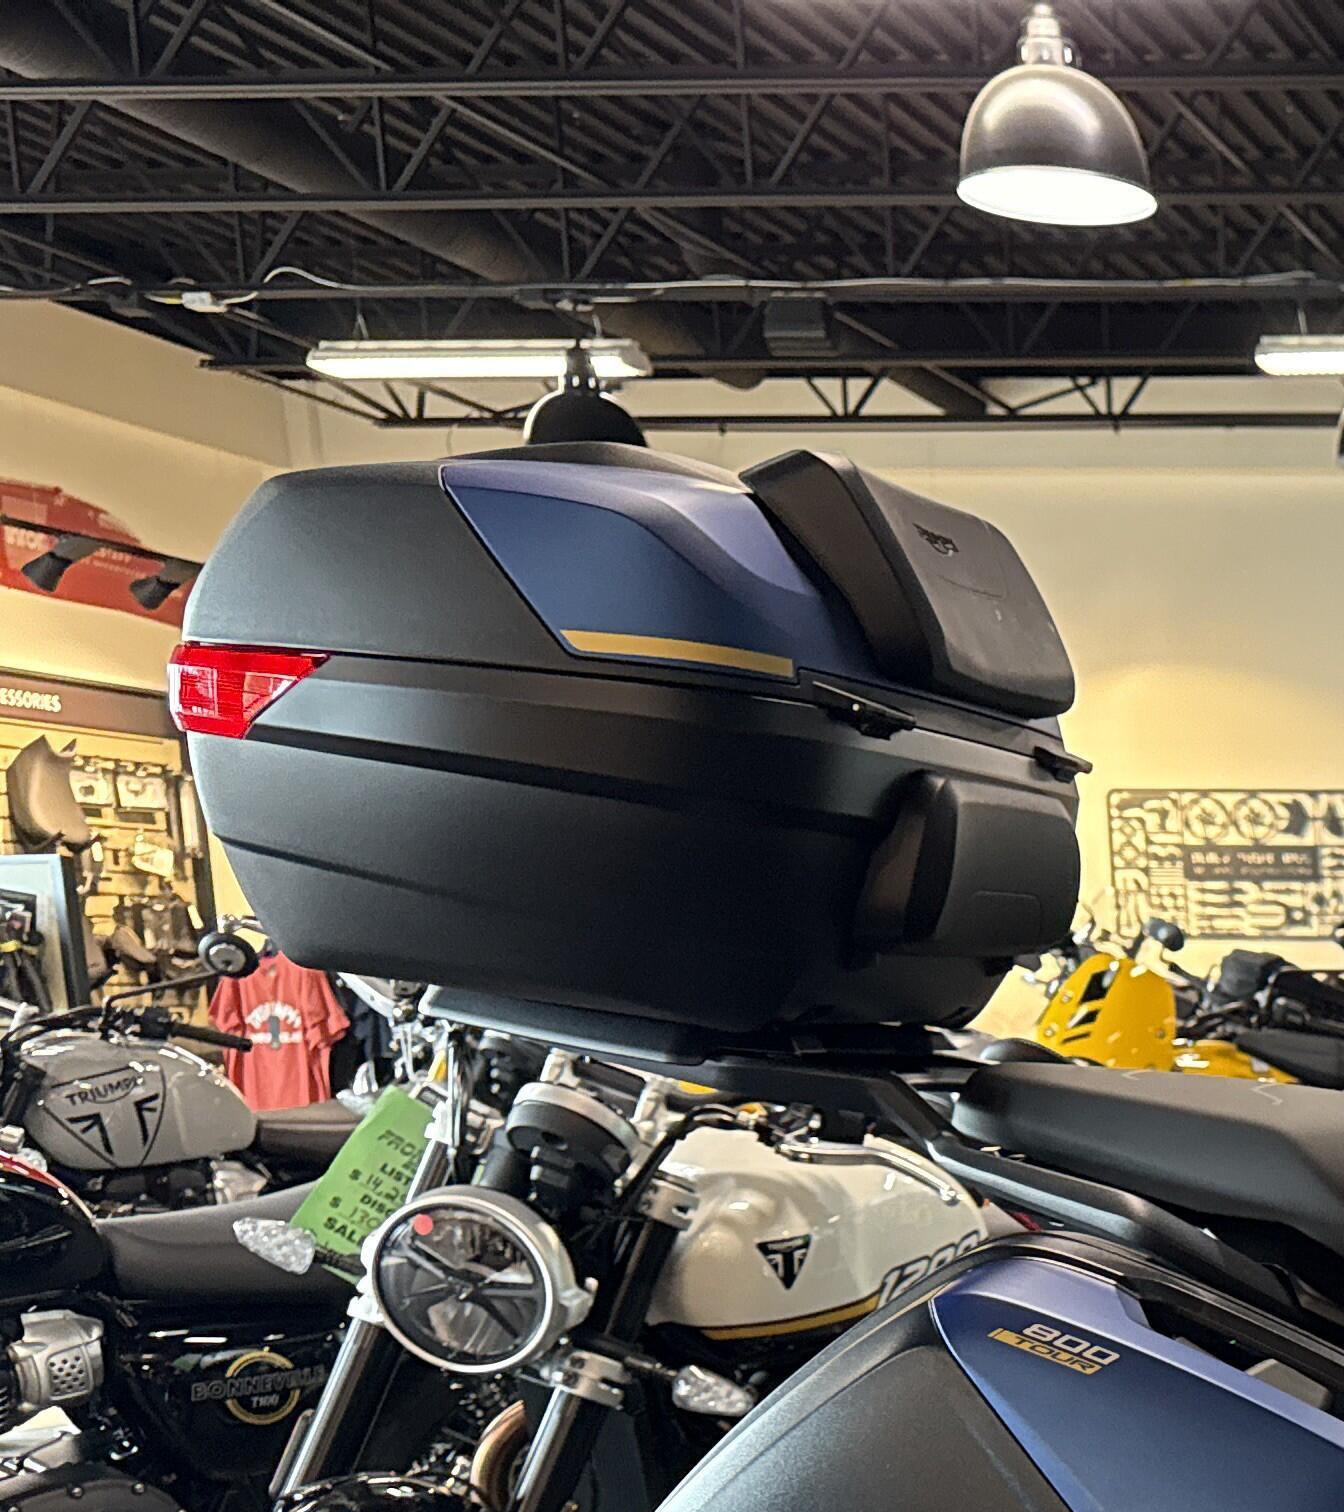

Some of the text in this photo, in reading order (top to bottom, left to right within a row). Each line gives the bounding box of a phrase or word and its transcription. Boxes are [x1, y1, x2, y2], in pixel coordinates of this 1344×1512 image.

[65, 1073, 143, 1106] TRIUMP
[379, 1162, 412, 1186] LIST
[1013, 1337, 1096, 1372] TOUR
[1022, 1323, 1121, 1366] 800
